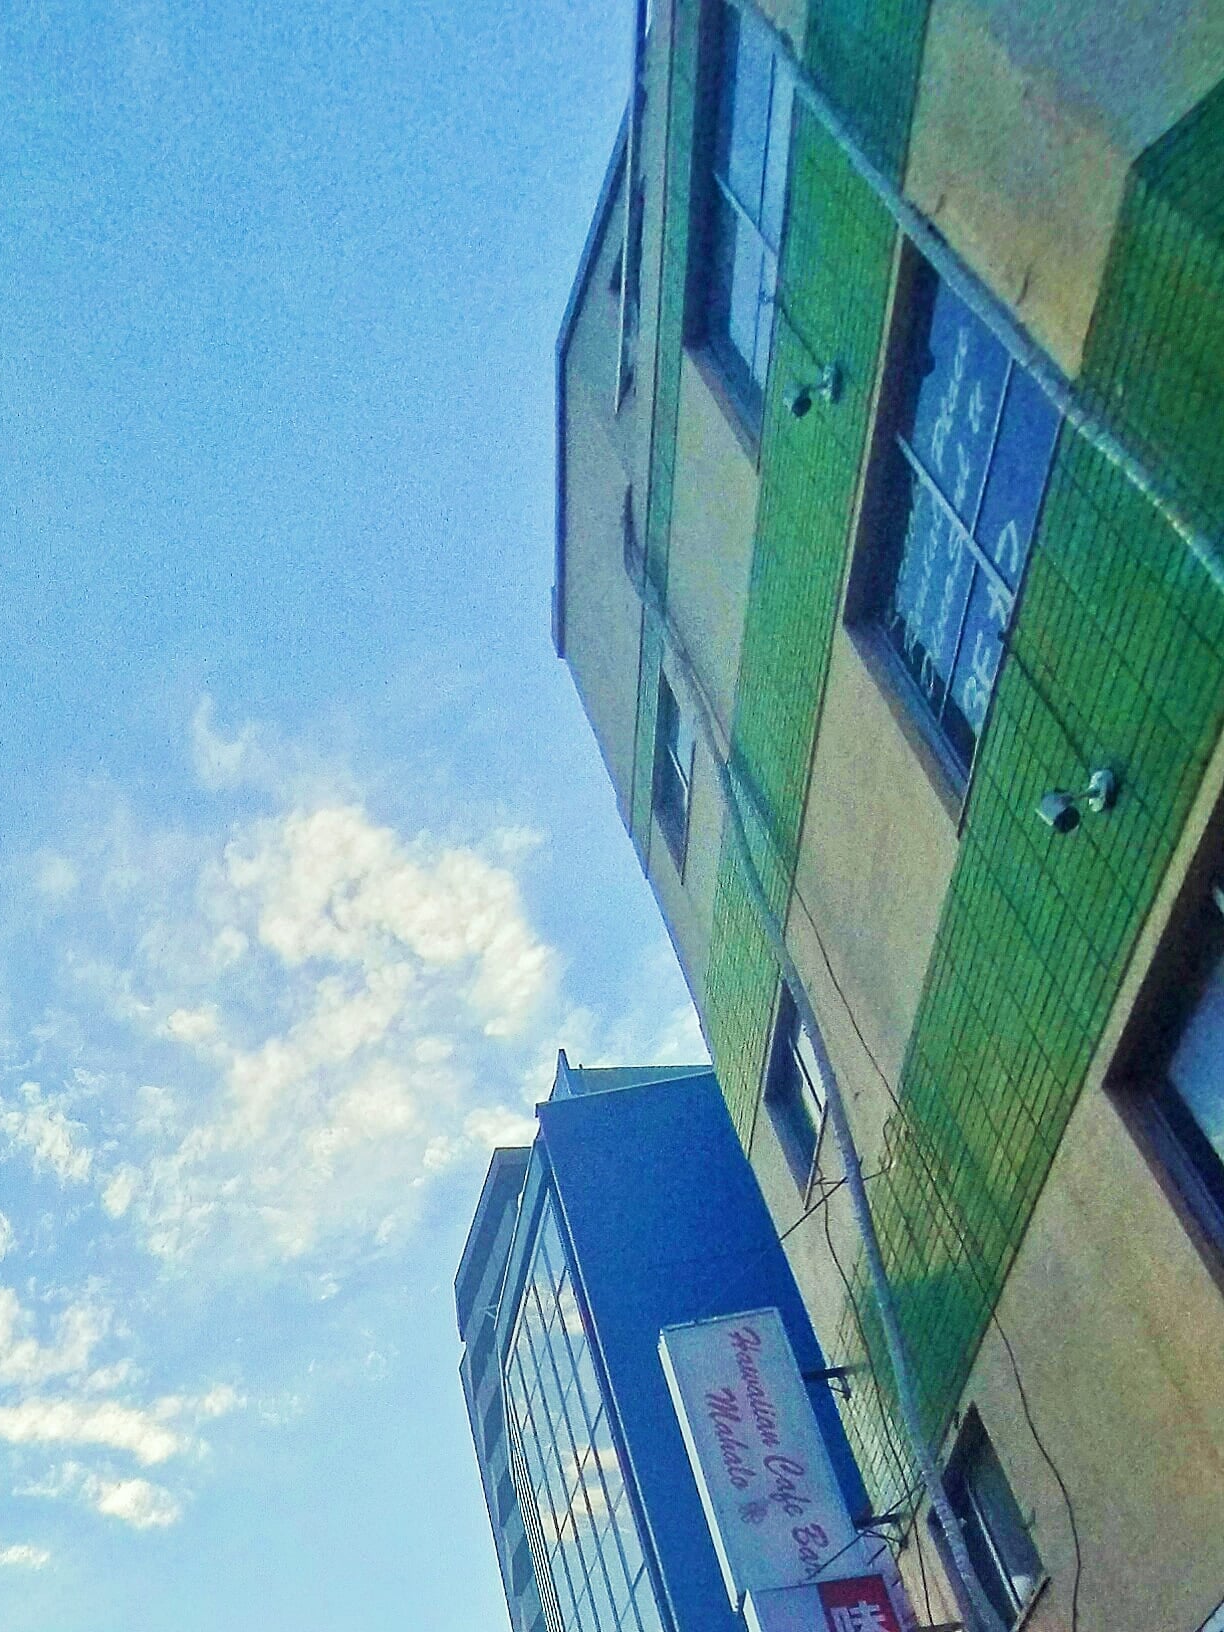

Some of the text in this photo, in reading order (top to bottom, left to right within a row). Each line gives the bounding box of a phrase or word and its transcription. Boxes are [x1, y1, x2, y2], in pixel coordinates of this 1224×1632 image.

[704, 1387, 756, 1490] Mahalo
[729, 1326, 780, 1448] Hawaiian
[791, 1522, 829, 1579] Bar
